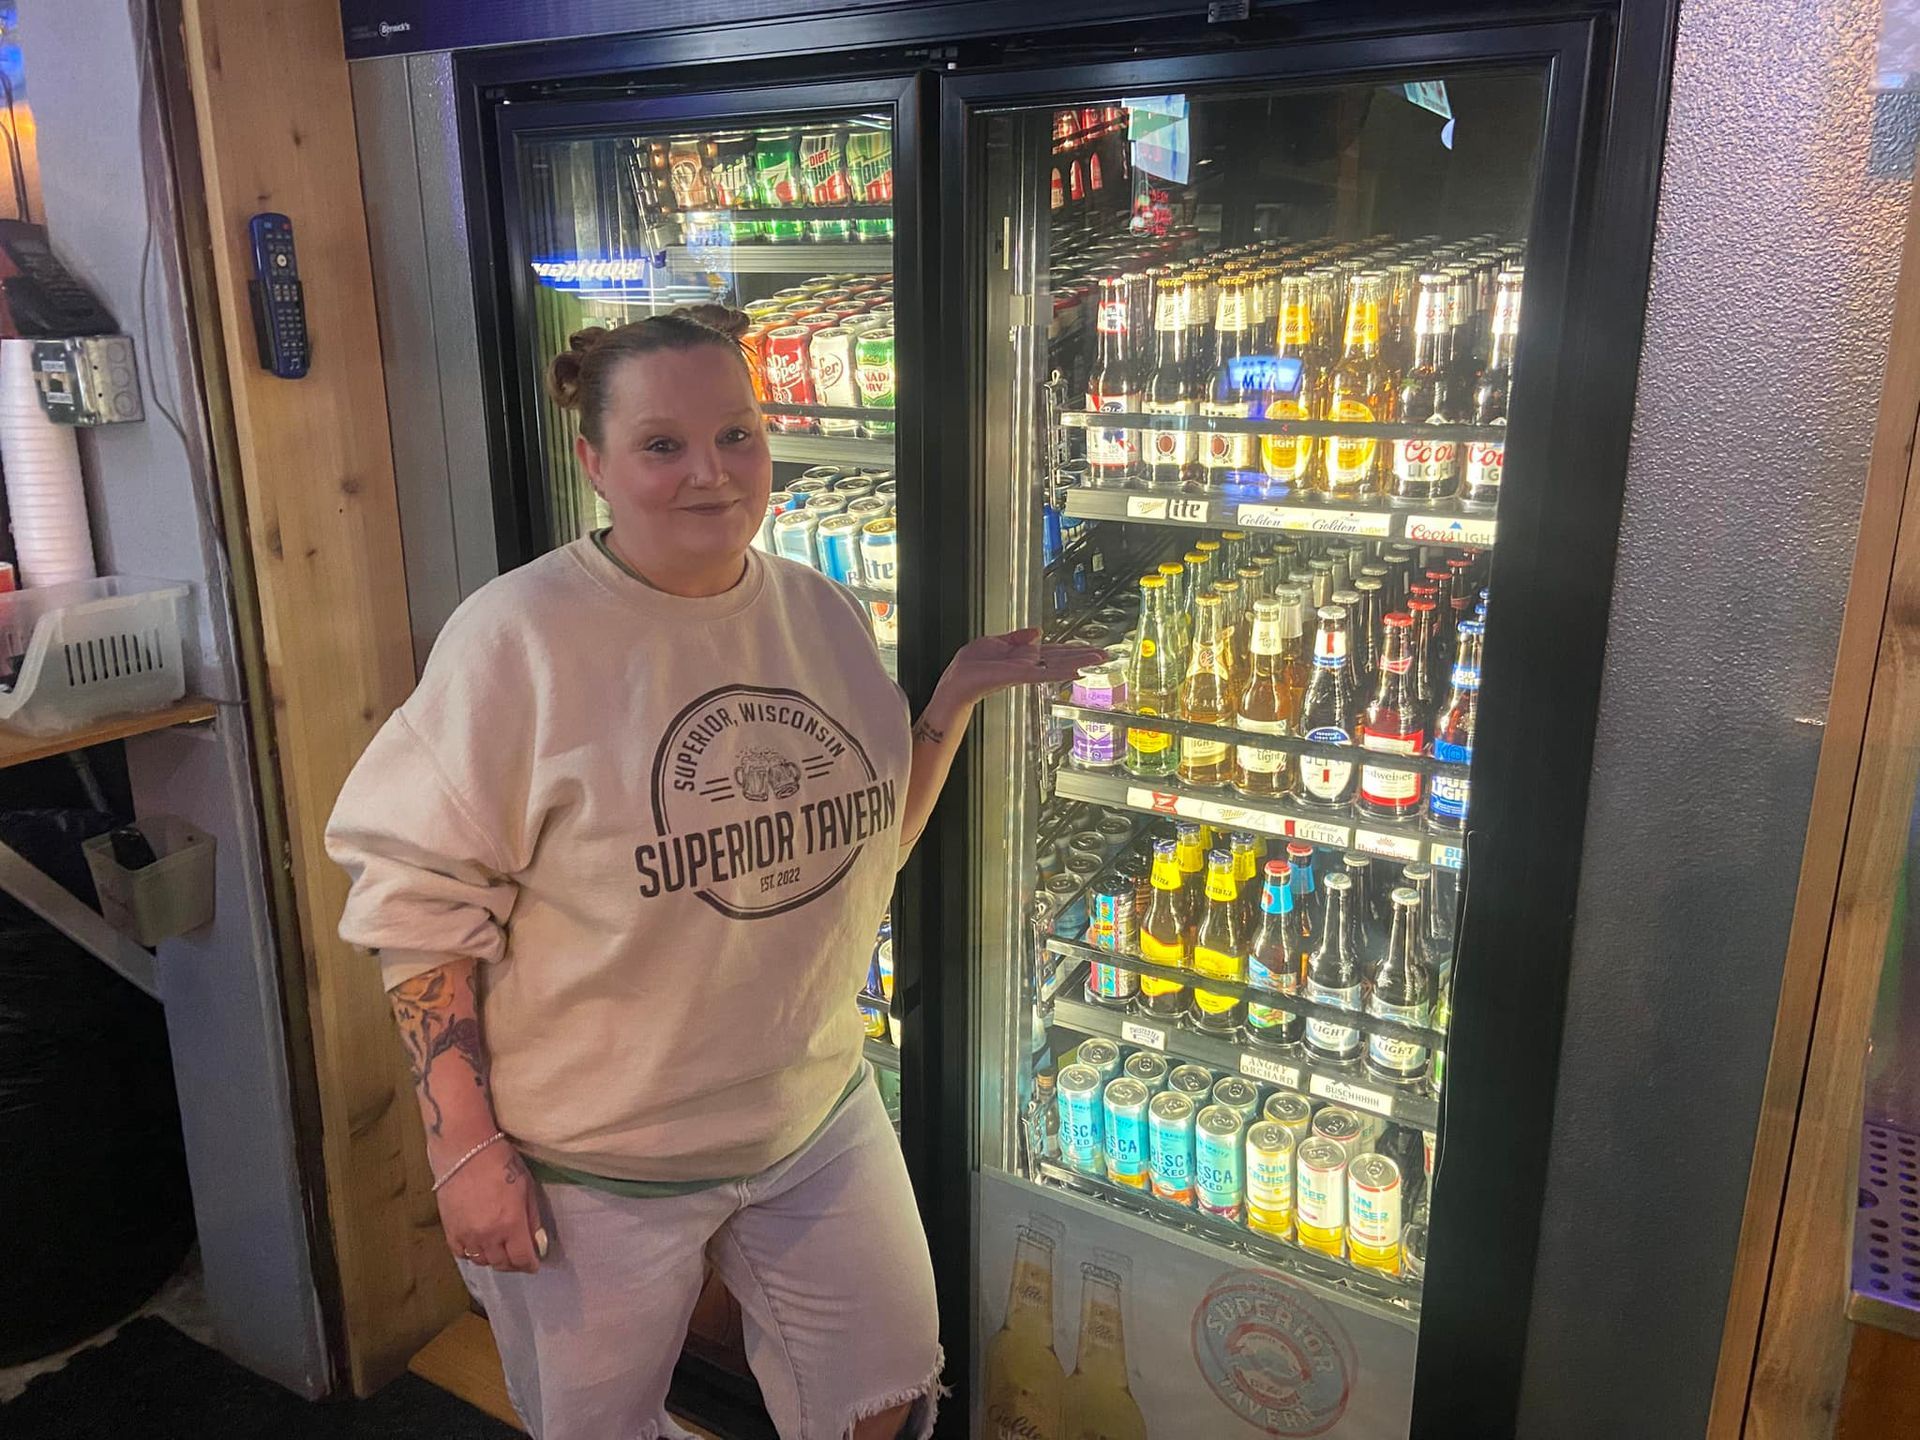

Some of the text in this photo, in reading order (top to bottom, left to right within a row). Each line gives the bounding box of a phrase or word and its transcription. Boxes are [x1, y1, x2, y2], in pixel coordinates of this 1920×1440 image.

[809, 149, 830, 168] DIET
[1407, 463, 1455, 479] LIGH
[1238, 513, 1282, 528] Golden
[1312, 518, 1358, 533] Golden
[1411, 523, 1455, 544] Coors
[673, 701, 846, 792] SUPERIOR, WISCONSIN
[634, 779, 896, 899] SUPERIOR TAVERN
[1299, 827, 1346, 846] ULTRA
[759, 867, 801, 893] EST. 2022
[1241, 1065, 1294, 1086] ORCHARD
[1248, 1056, 1287, 1074] ANGRY
[1205, 1297, 1335, 1373] SUPERIOR
[1219, 1373, 1316, 1426] TAVERN
